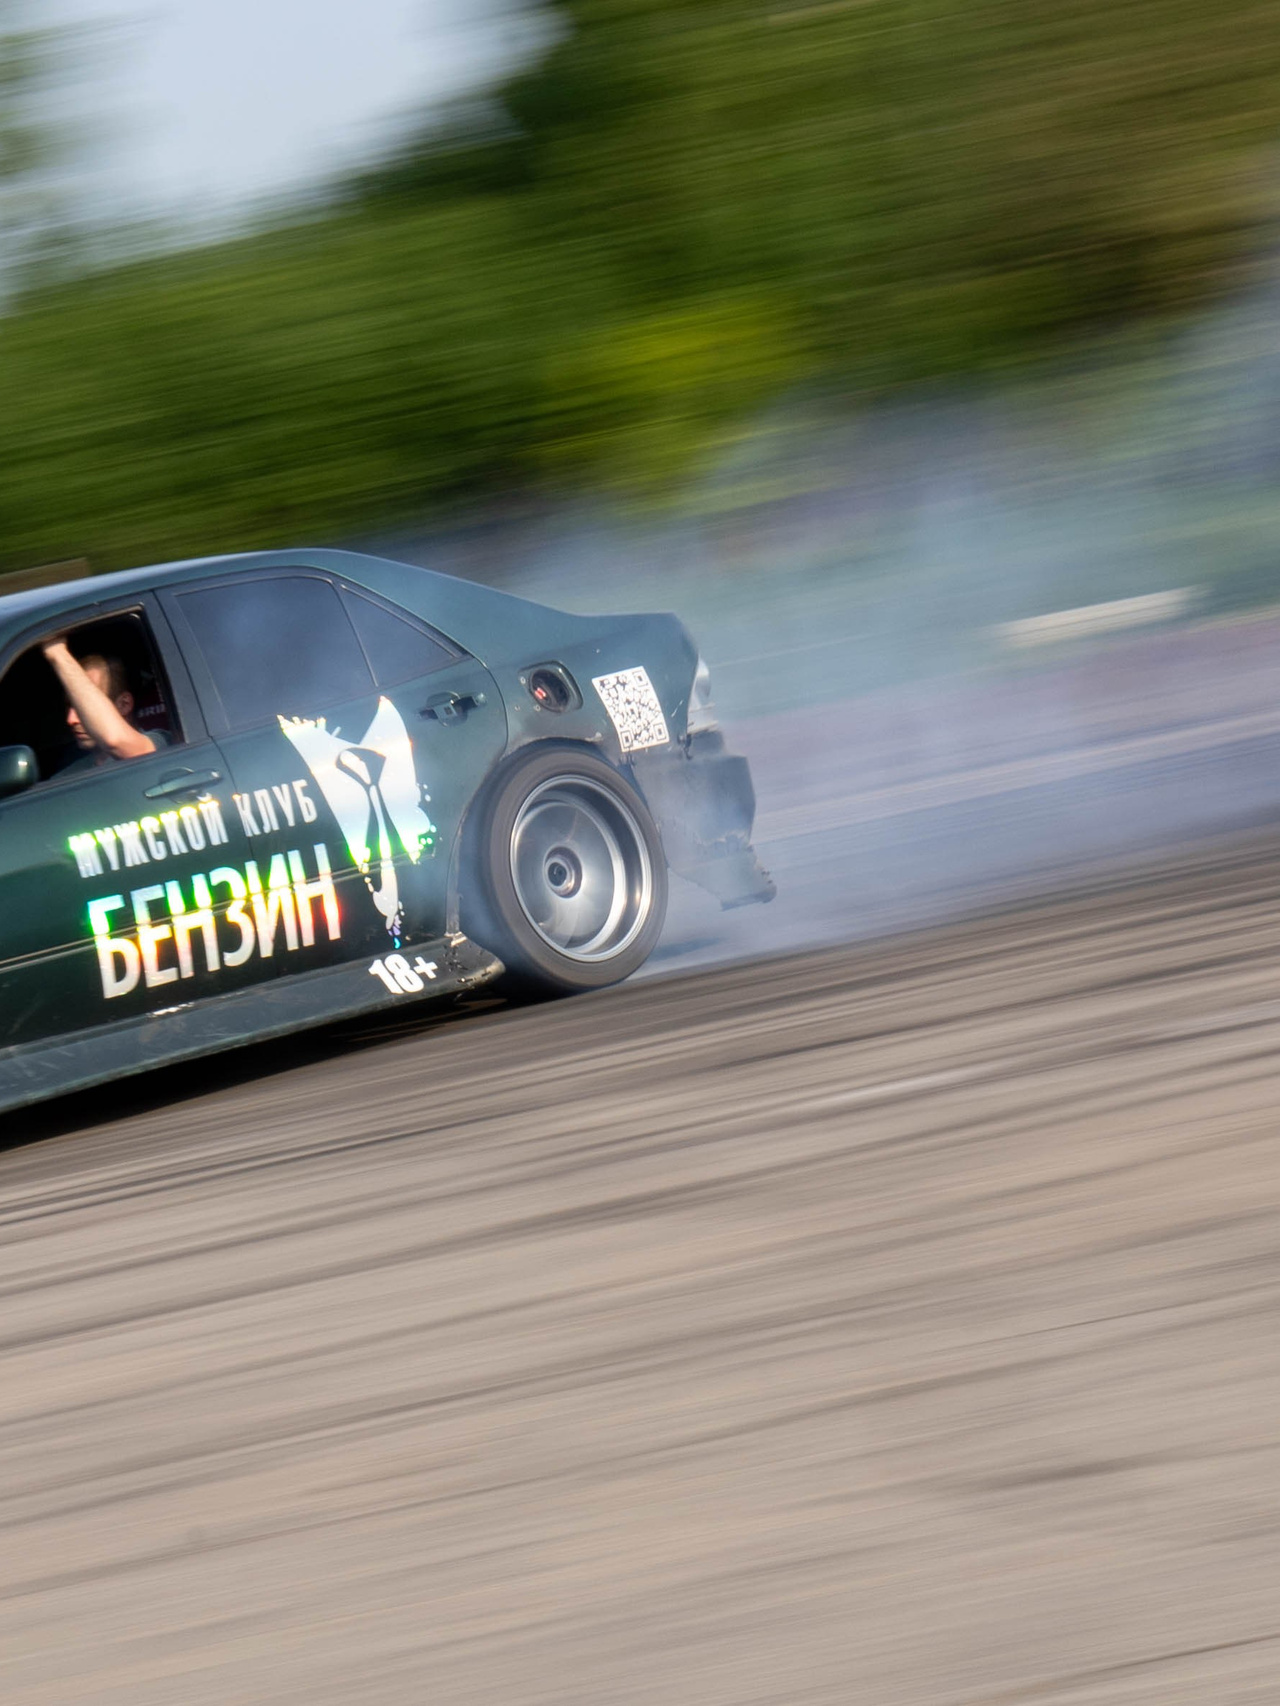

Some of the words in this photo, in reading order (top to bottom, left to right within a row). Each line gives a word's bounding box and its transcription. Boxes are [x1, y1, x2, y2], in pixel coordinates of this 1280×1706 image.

[68, 795, 229, 878] МУЖСКОЙ
[233, 778, 319, 838] КЛУБ
[87, 842, 343, 1000] БЕНЗИН
[368, 953, 438, 994] 18+
